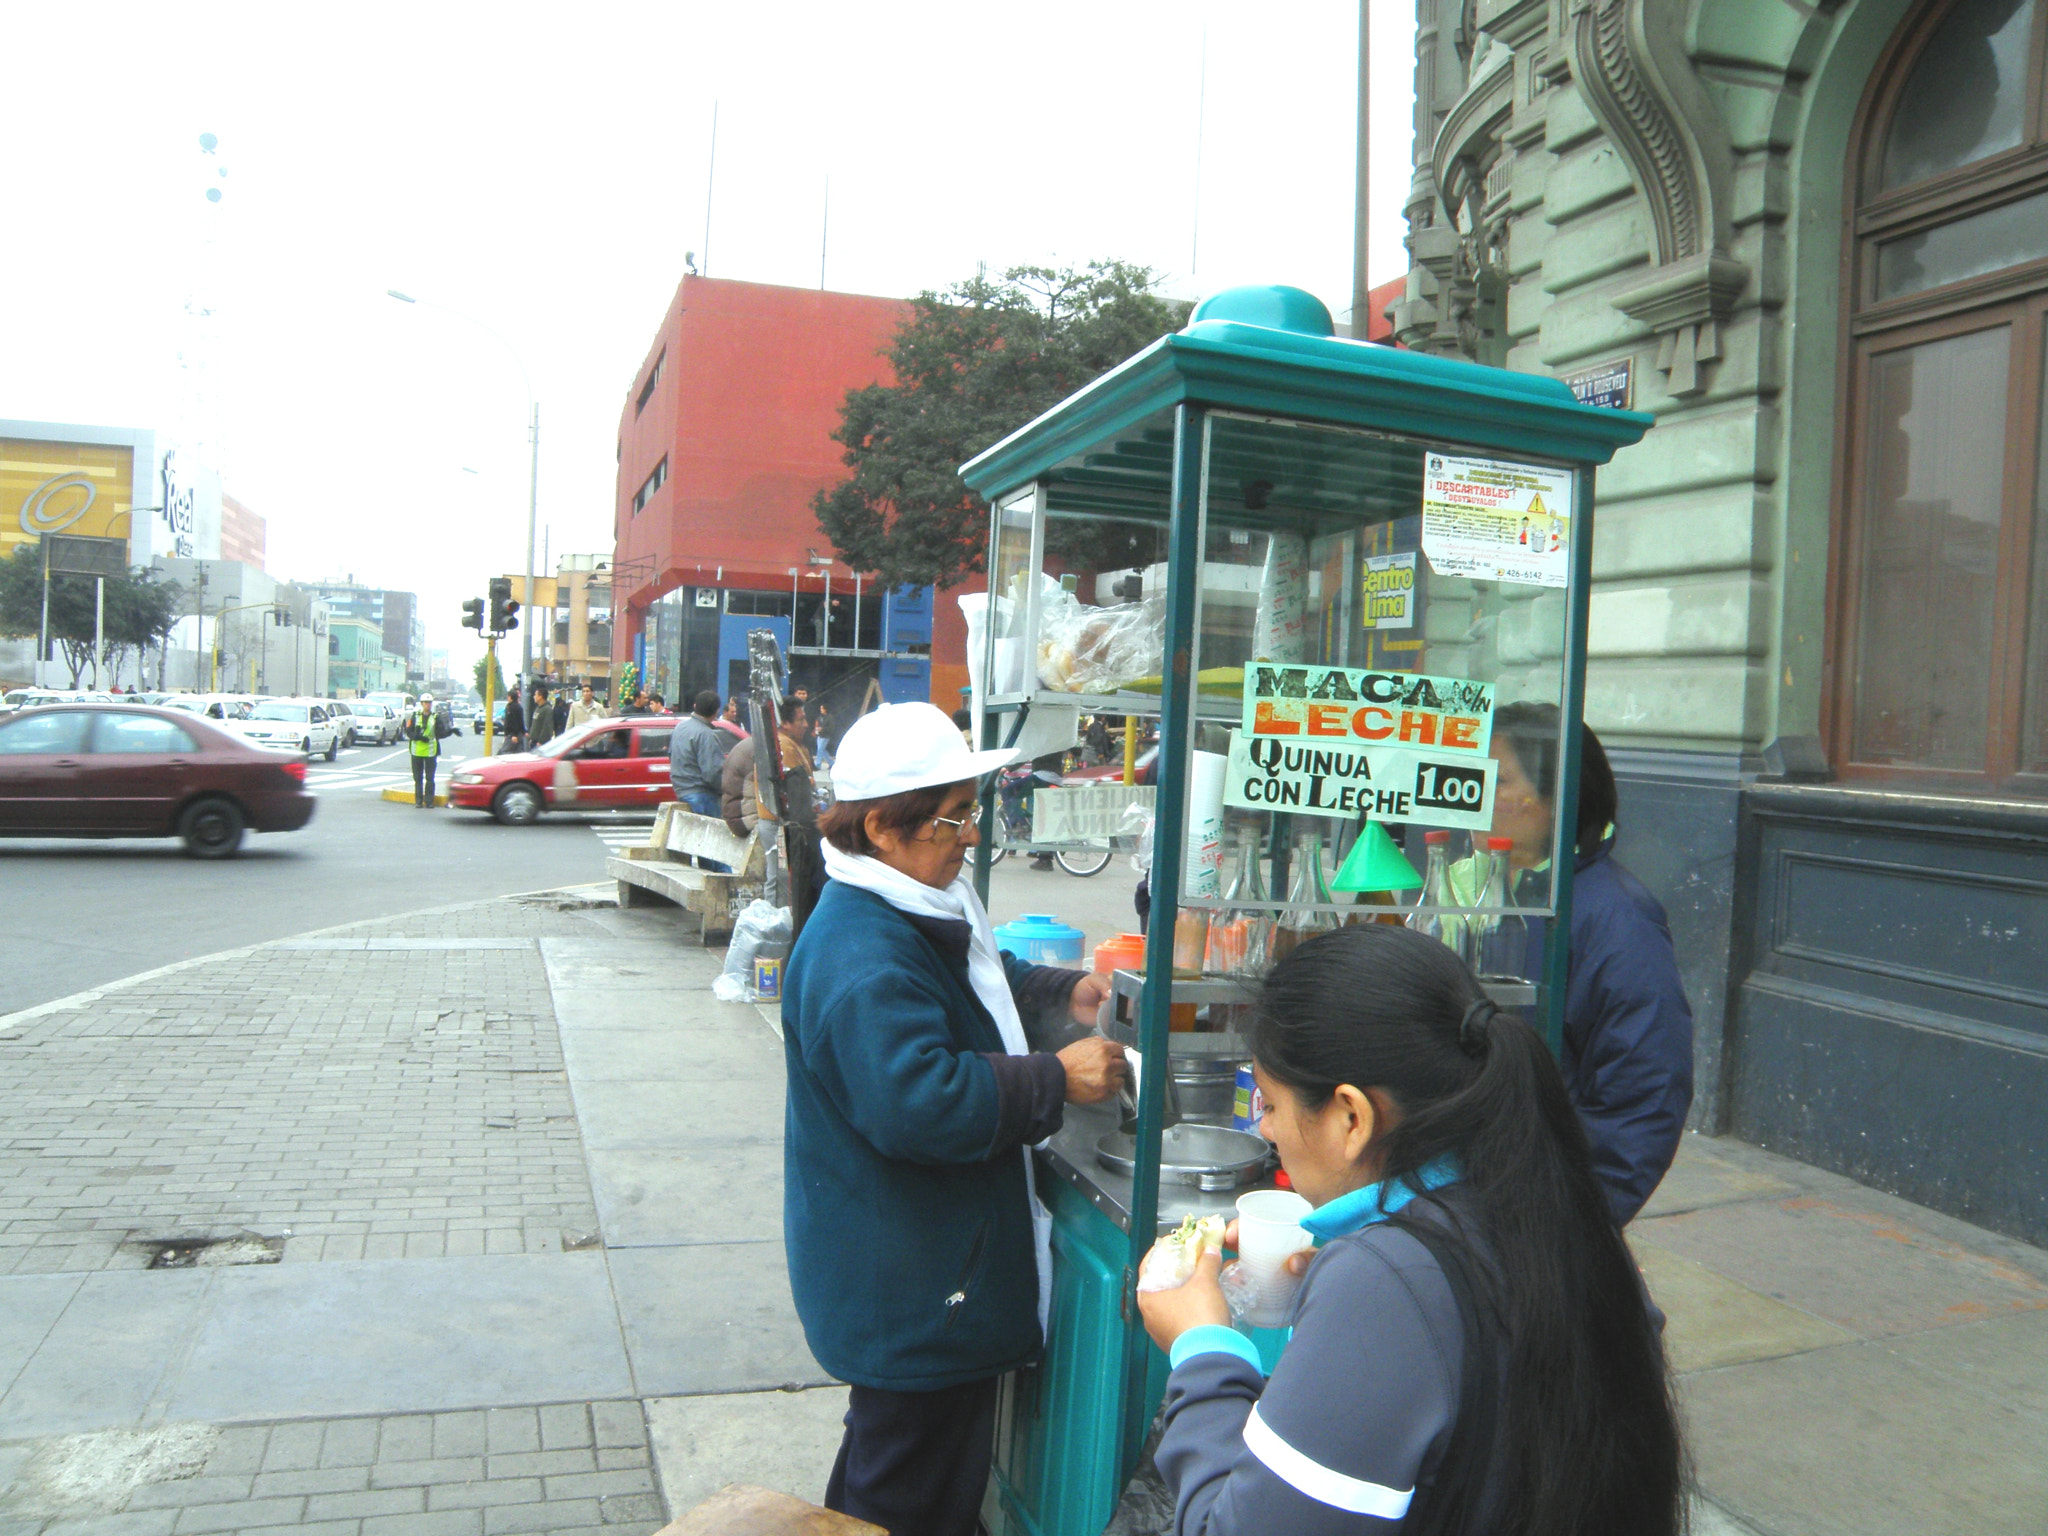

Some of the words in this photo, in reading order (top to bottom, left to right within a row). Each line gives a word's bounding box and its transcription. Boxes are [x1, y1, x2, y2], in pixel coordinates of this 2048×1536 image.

[162, 468, 194, 533] Real
[1255, 667, 1443, 709] MACA
[1253, 702, 1481, 749] LECHE
[1250, 738, 1372, 780] QUINUA
[1244, 777, 1301, 806] CON
[1306, 774, 1411, 816] LECHE
[1417, 766, 1482, 804] 1.00
